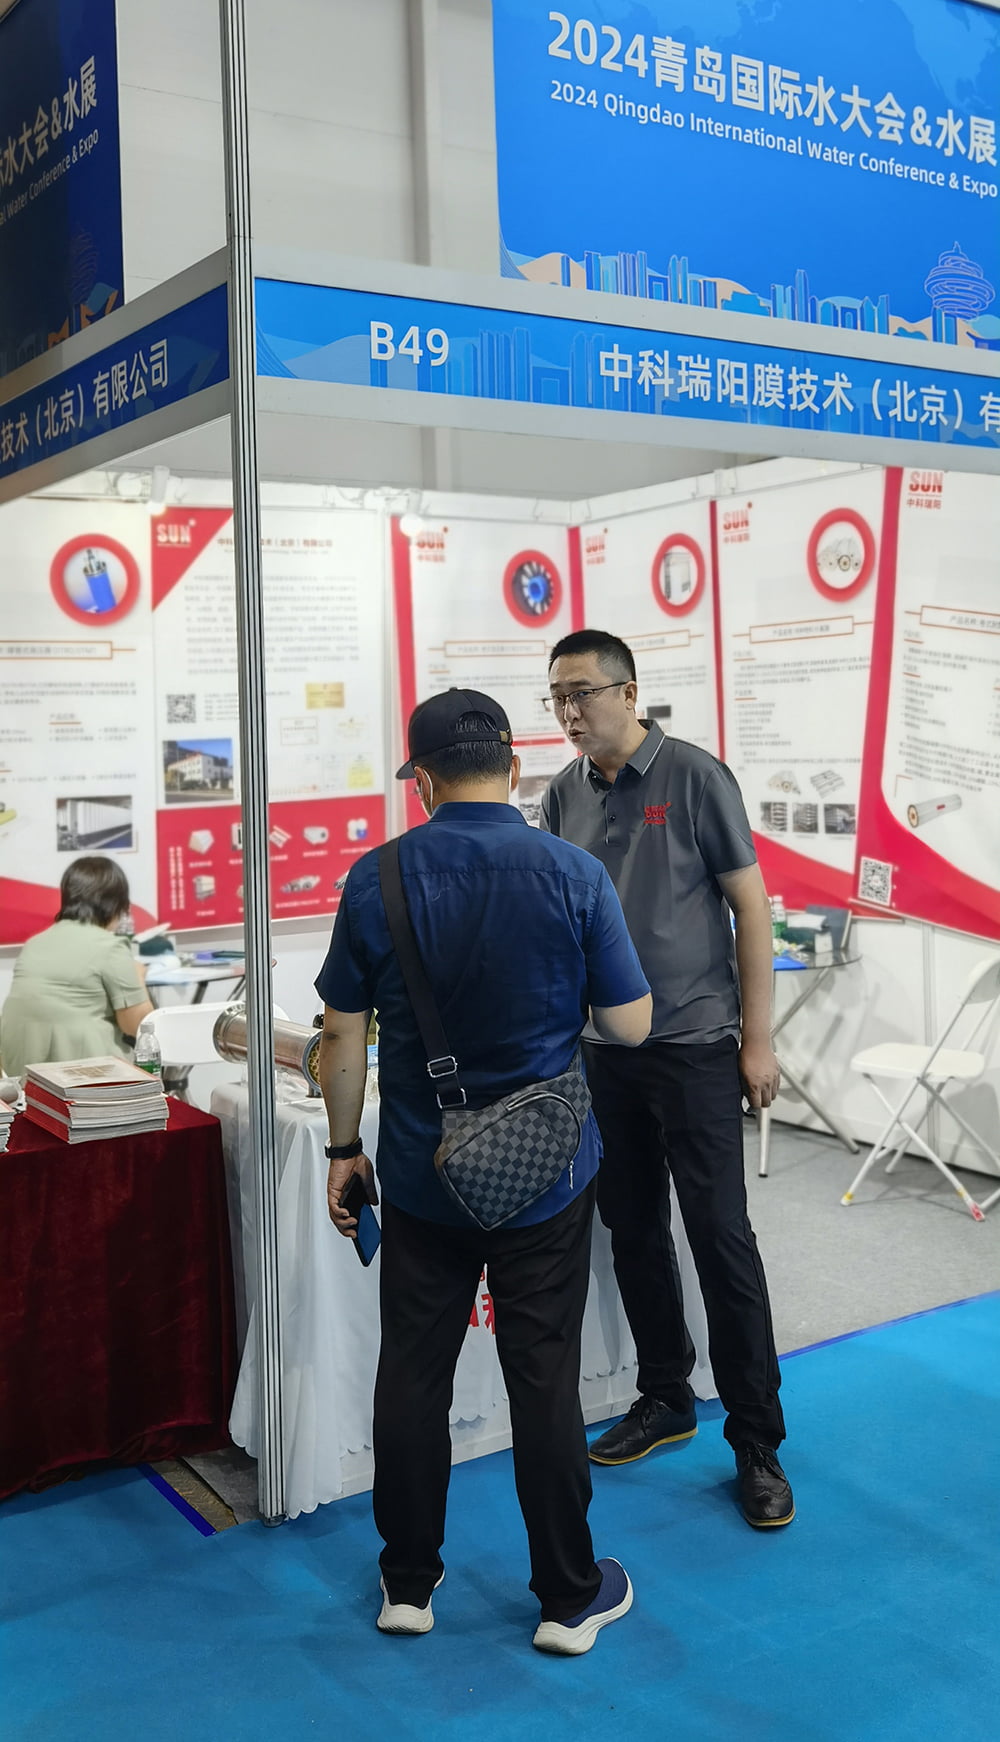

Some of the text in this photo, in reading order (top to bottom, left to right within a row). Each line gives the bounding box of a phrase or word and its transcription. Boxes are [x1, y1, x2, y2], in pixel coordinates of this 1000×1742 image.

[548, 11, 998, 167] 2024青岛国际水大会&水展
[29, 154, 70, 200] Conference
[72, 145, 78, 164] &
[79, 128, 99, 159] Expo
[551, 80, 998, 199] 2024 Qingdao International Water Conference & Expo
[370, 320, 450, 367] B49
[0, 339, 168, 464] 技术（北京）有限公司
[909, 470, 944, 493] SUN
[157, 524, 191, 543] SUN
[723, 510, 749, 530] SUN
